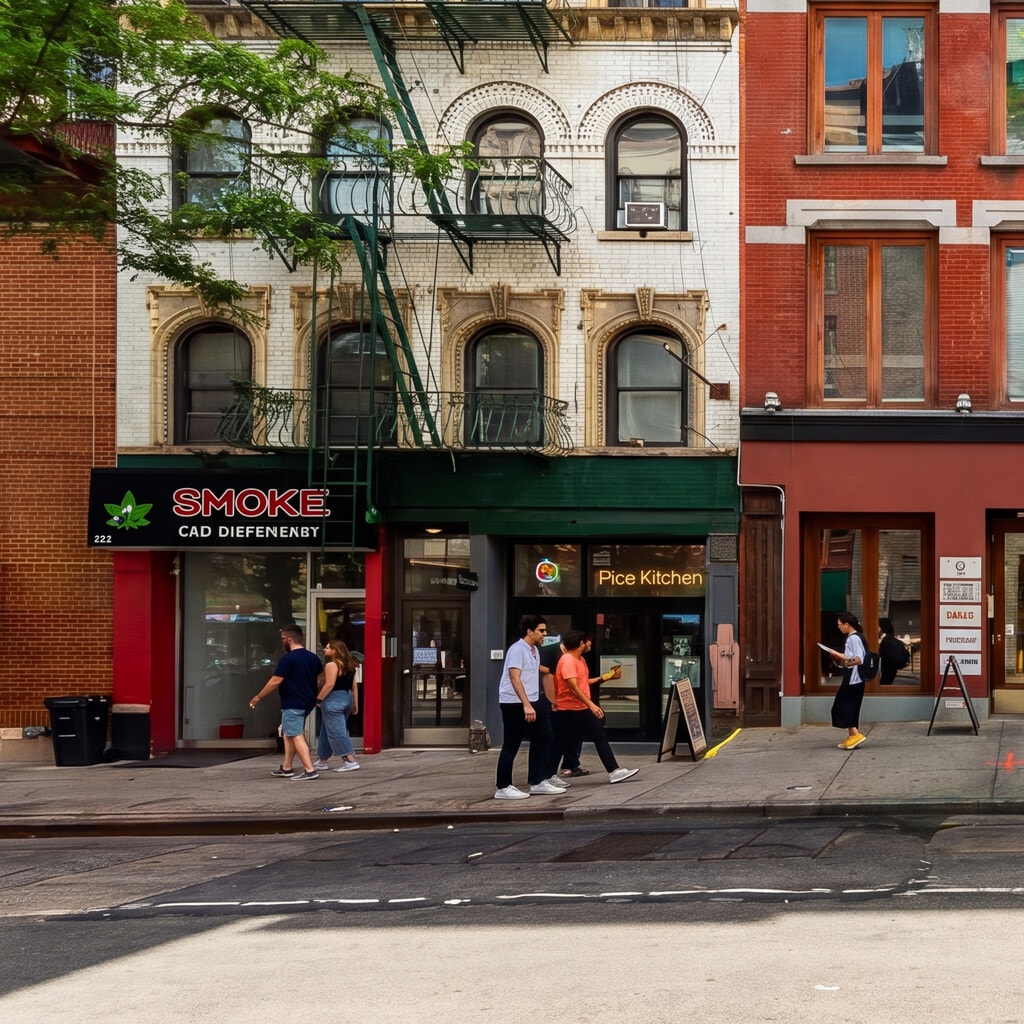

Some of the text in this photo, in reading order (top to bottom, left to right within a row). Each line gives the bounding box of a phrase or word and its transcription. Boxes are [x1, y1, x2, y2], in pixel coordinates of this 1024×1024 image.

[172, 487, 331, 518] SMOKE
[178, 525, 212, 538] CAD
[93, 535, 112, 543] 222
[599, 569, 703, 585] Pice Kitchen
